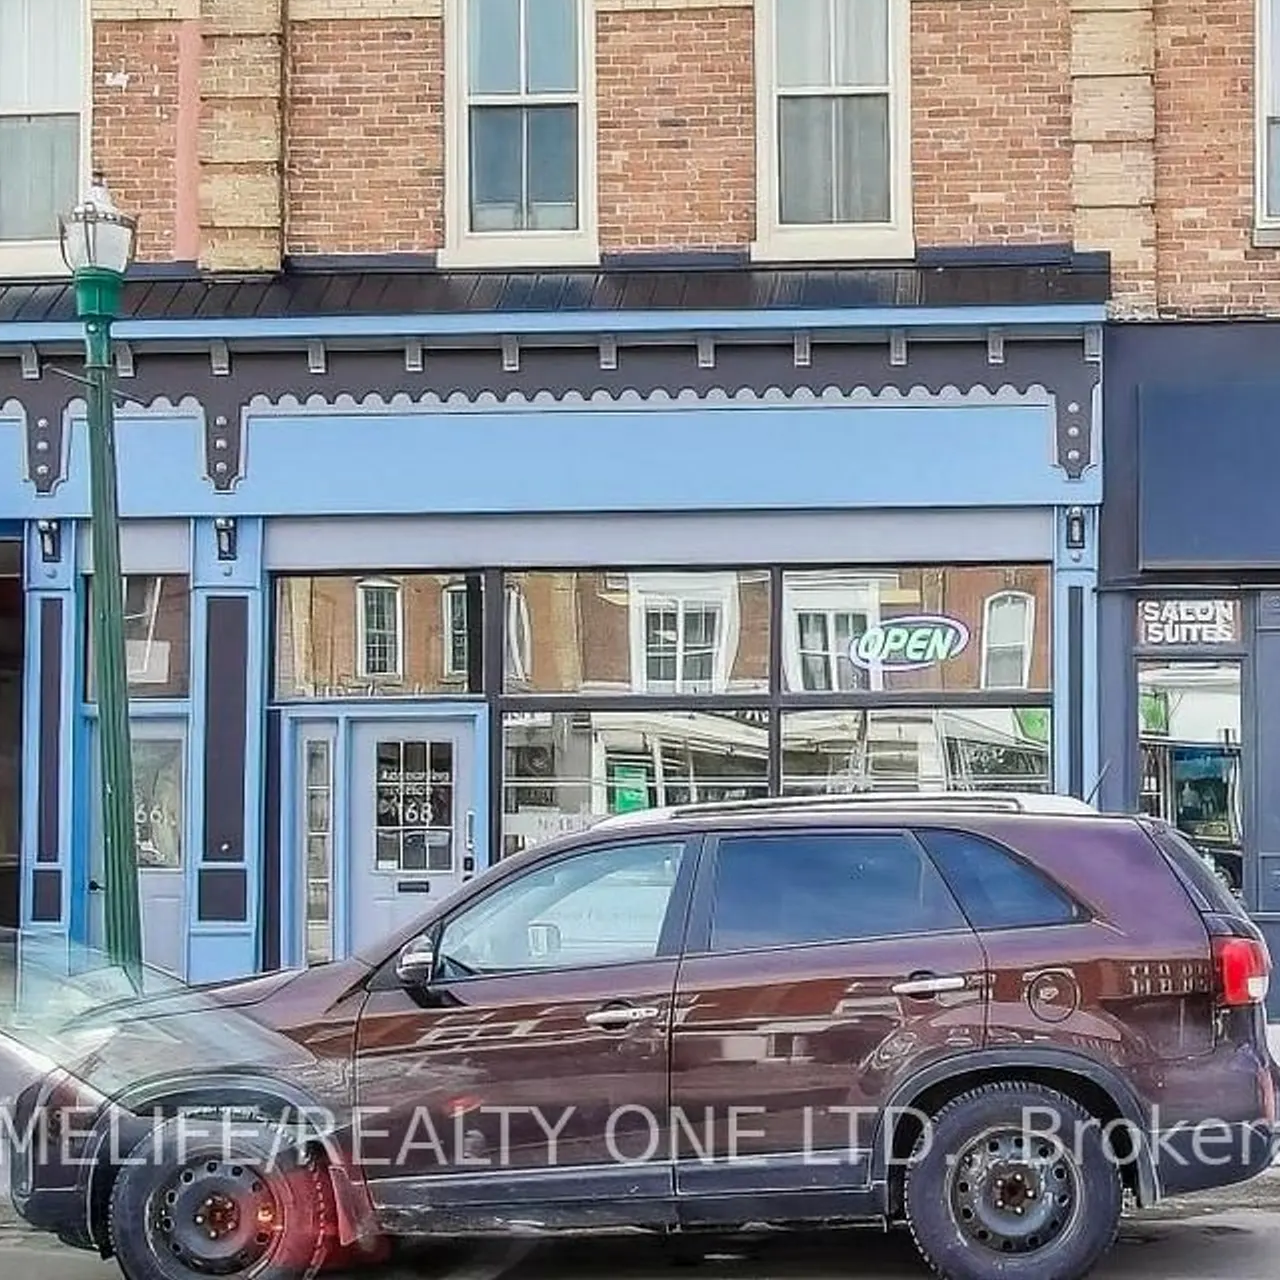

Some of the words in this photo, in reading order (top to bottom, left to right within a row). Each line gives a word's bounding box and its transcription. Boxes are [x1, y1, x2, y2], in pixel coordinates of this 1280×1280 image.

[1143, 600, 1233, 621] SALON
[858, 626, 953, 660] OPEN
[1147, 623, 1234, 643] SUITES
